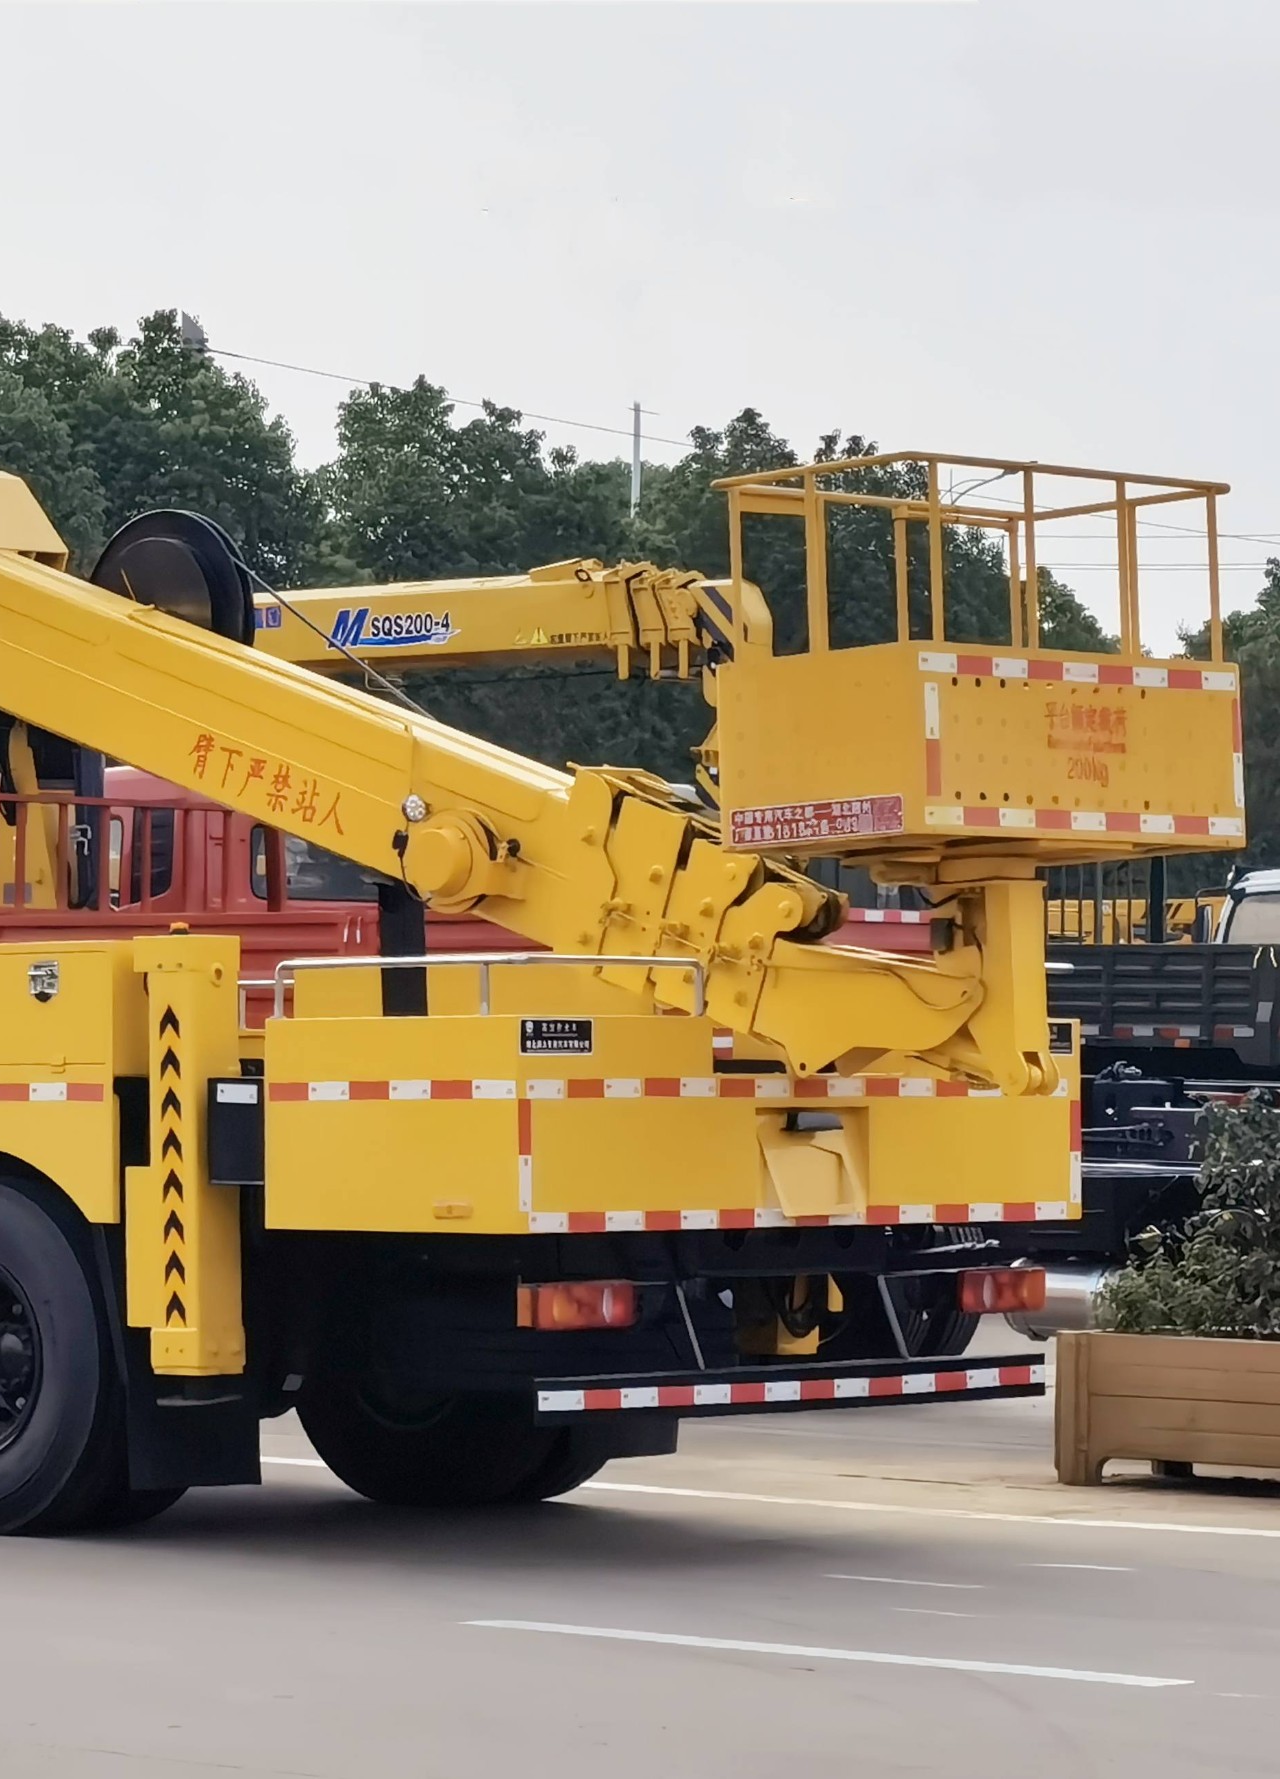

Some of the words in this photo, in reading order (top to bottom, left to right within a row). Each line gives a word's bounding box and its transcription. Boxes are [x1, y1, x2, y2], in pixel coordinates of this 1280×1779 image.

[371, 612, 450, 637] SQS200-4
[188, 733, 344, 835] 臂下严禁站人
